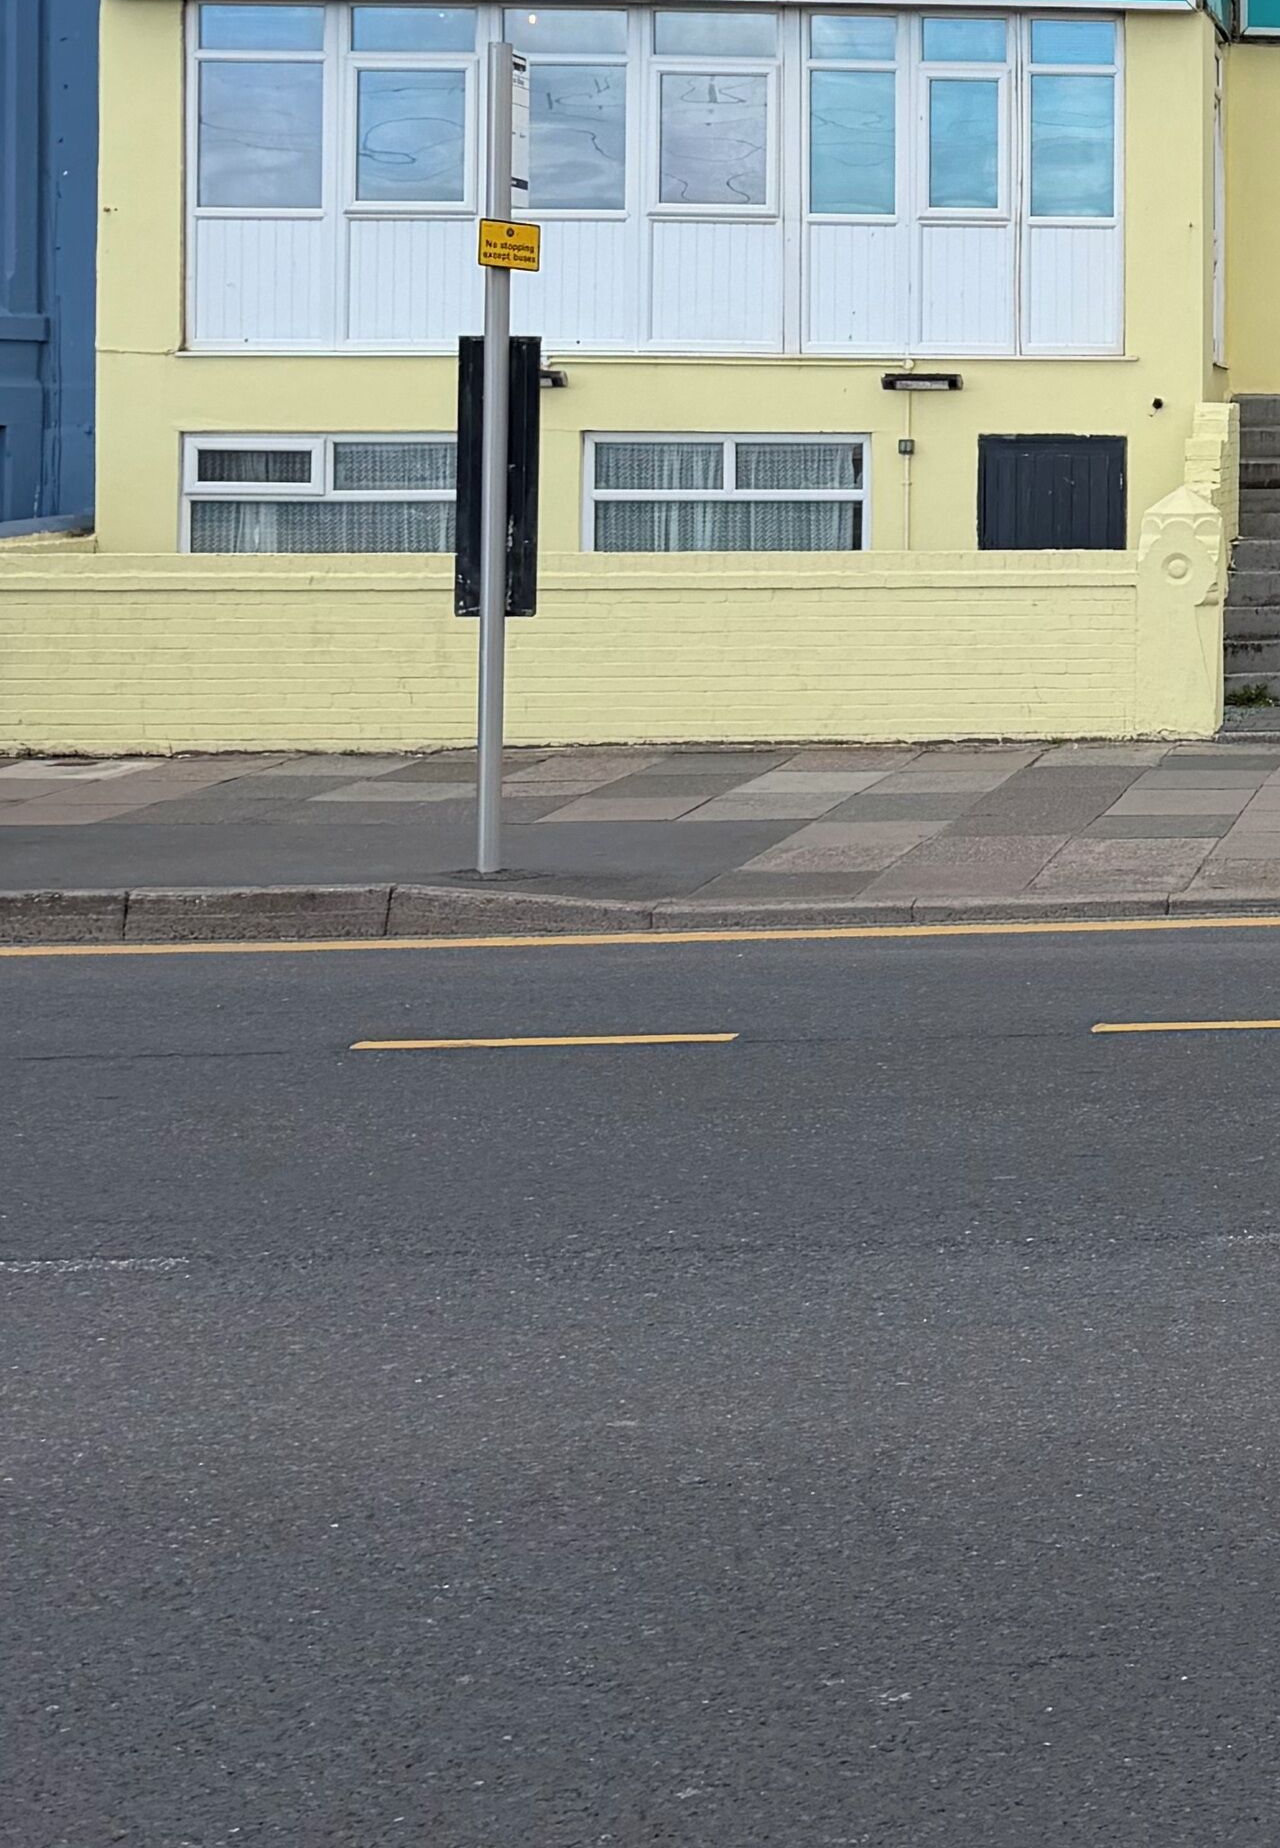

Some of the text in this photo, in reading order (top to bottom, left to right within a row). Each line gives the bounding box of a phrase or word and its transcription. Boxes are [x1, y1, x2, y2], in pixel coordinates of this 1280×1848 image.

[485, 239, 535, 254] No stopping
[483, 251, 536, 263] except buses
